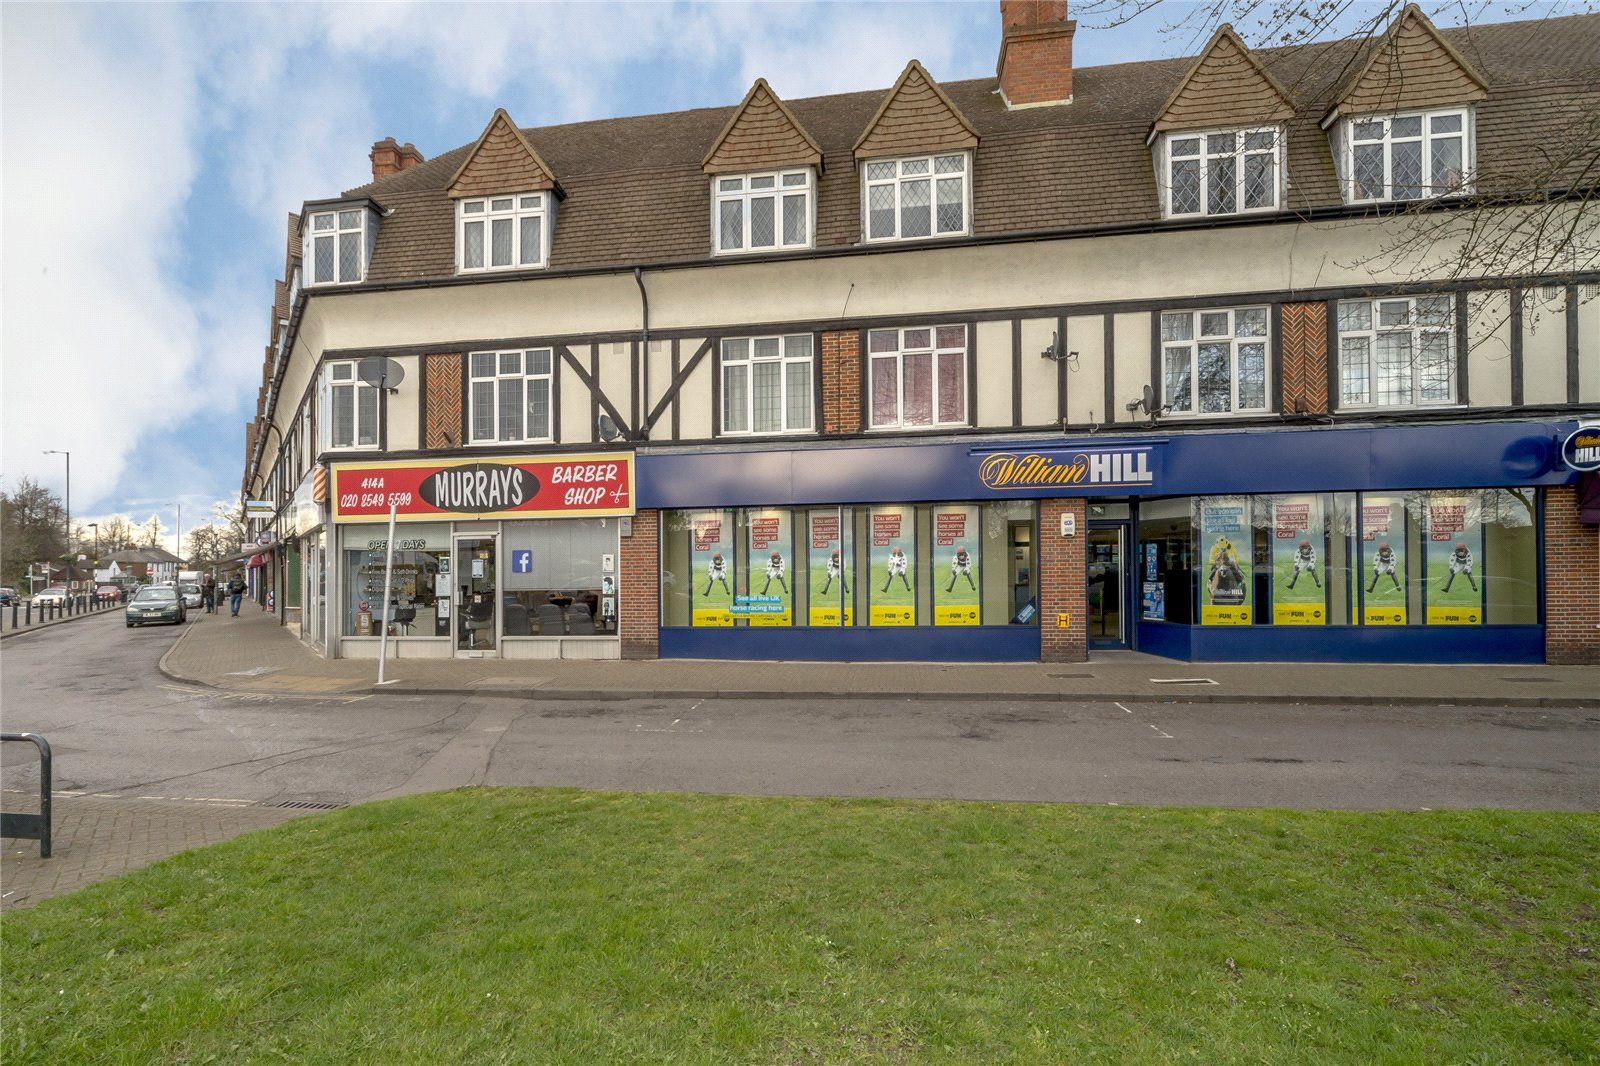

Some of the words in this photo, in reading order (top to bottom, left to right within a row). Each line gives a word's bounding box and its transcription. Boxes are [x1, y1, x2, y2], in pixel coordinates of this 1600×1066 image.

[1575, 447, 1600, 463] HILL
[552, 464, 618, 484] BARBER
[979, 453, 1090, 488] William
[1090, 453, 1153, 482] HILL
[361, 477, 385, 489] 414A
[435, 467, 523, 508] MURRAYS
[341, 494, 358, 507] 020
[361, 493, 385, 506] 8549
[387, 492, 412, 506] 5599
[565, 487, 606, 505] SHOP
[402, 539, 426, 550] DAYS
[1059, 615, 1068, 626] H
